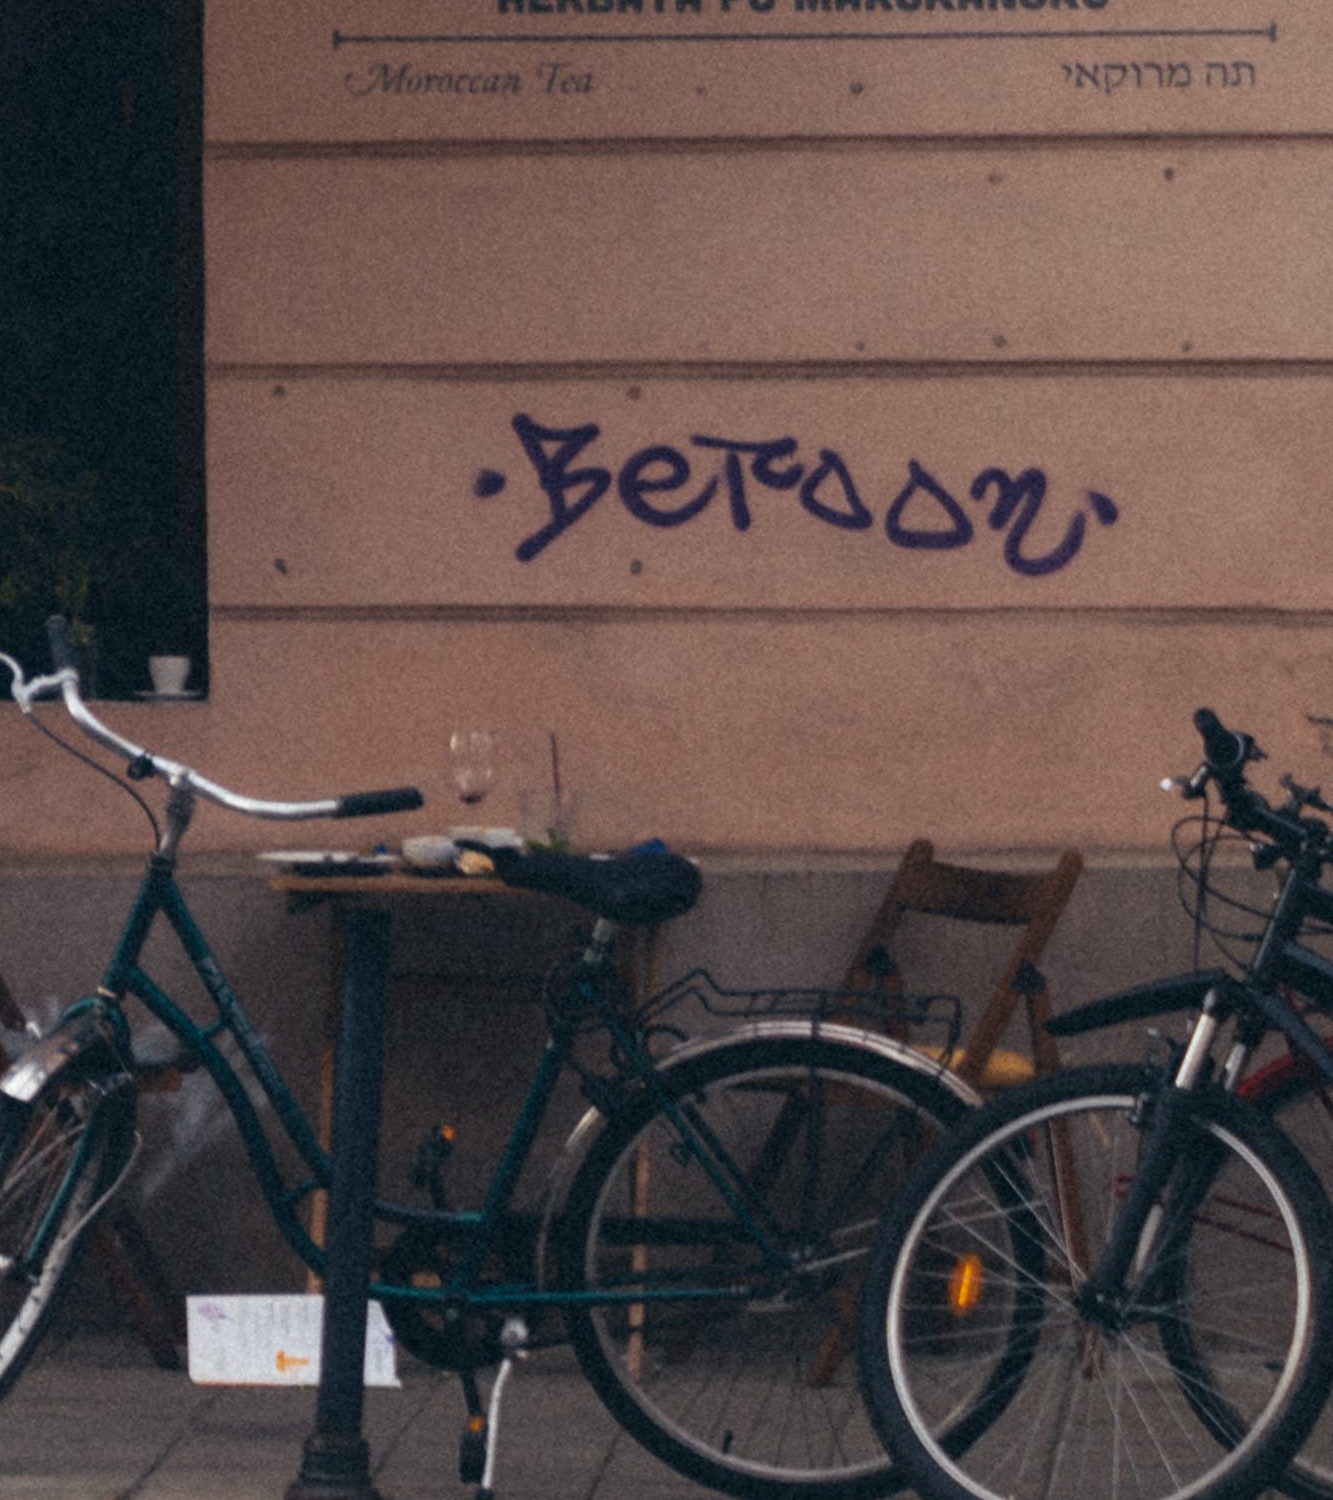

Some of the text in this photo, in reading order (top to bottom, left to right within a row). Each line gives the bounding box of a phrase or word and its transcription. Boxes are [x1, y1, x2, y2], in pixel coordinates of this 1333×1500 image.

[344, 60, 595, 97] Moroccan Tea
[1061, 60, 1256, 95] תה מרוקאי
